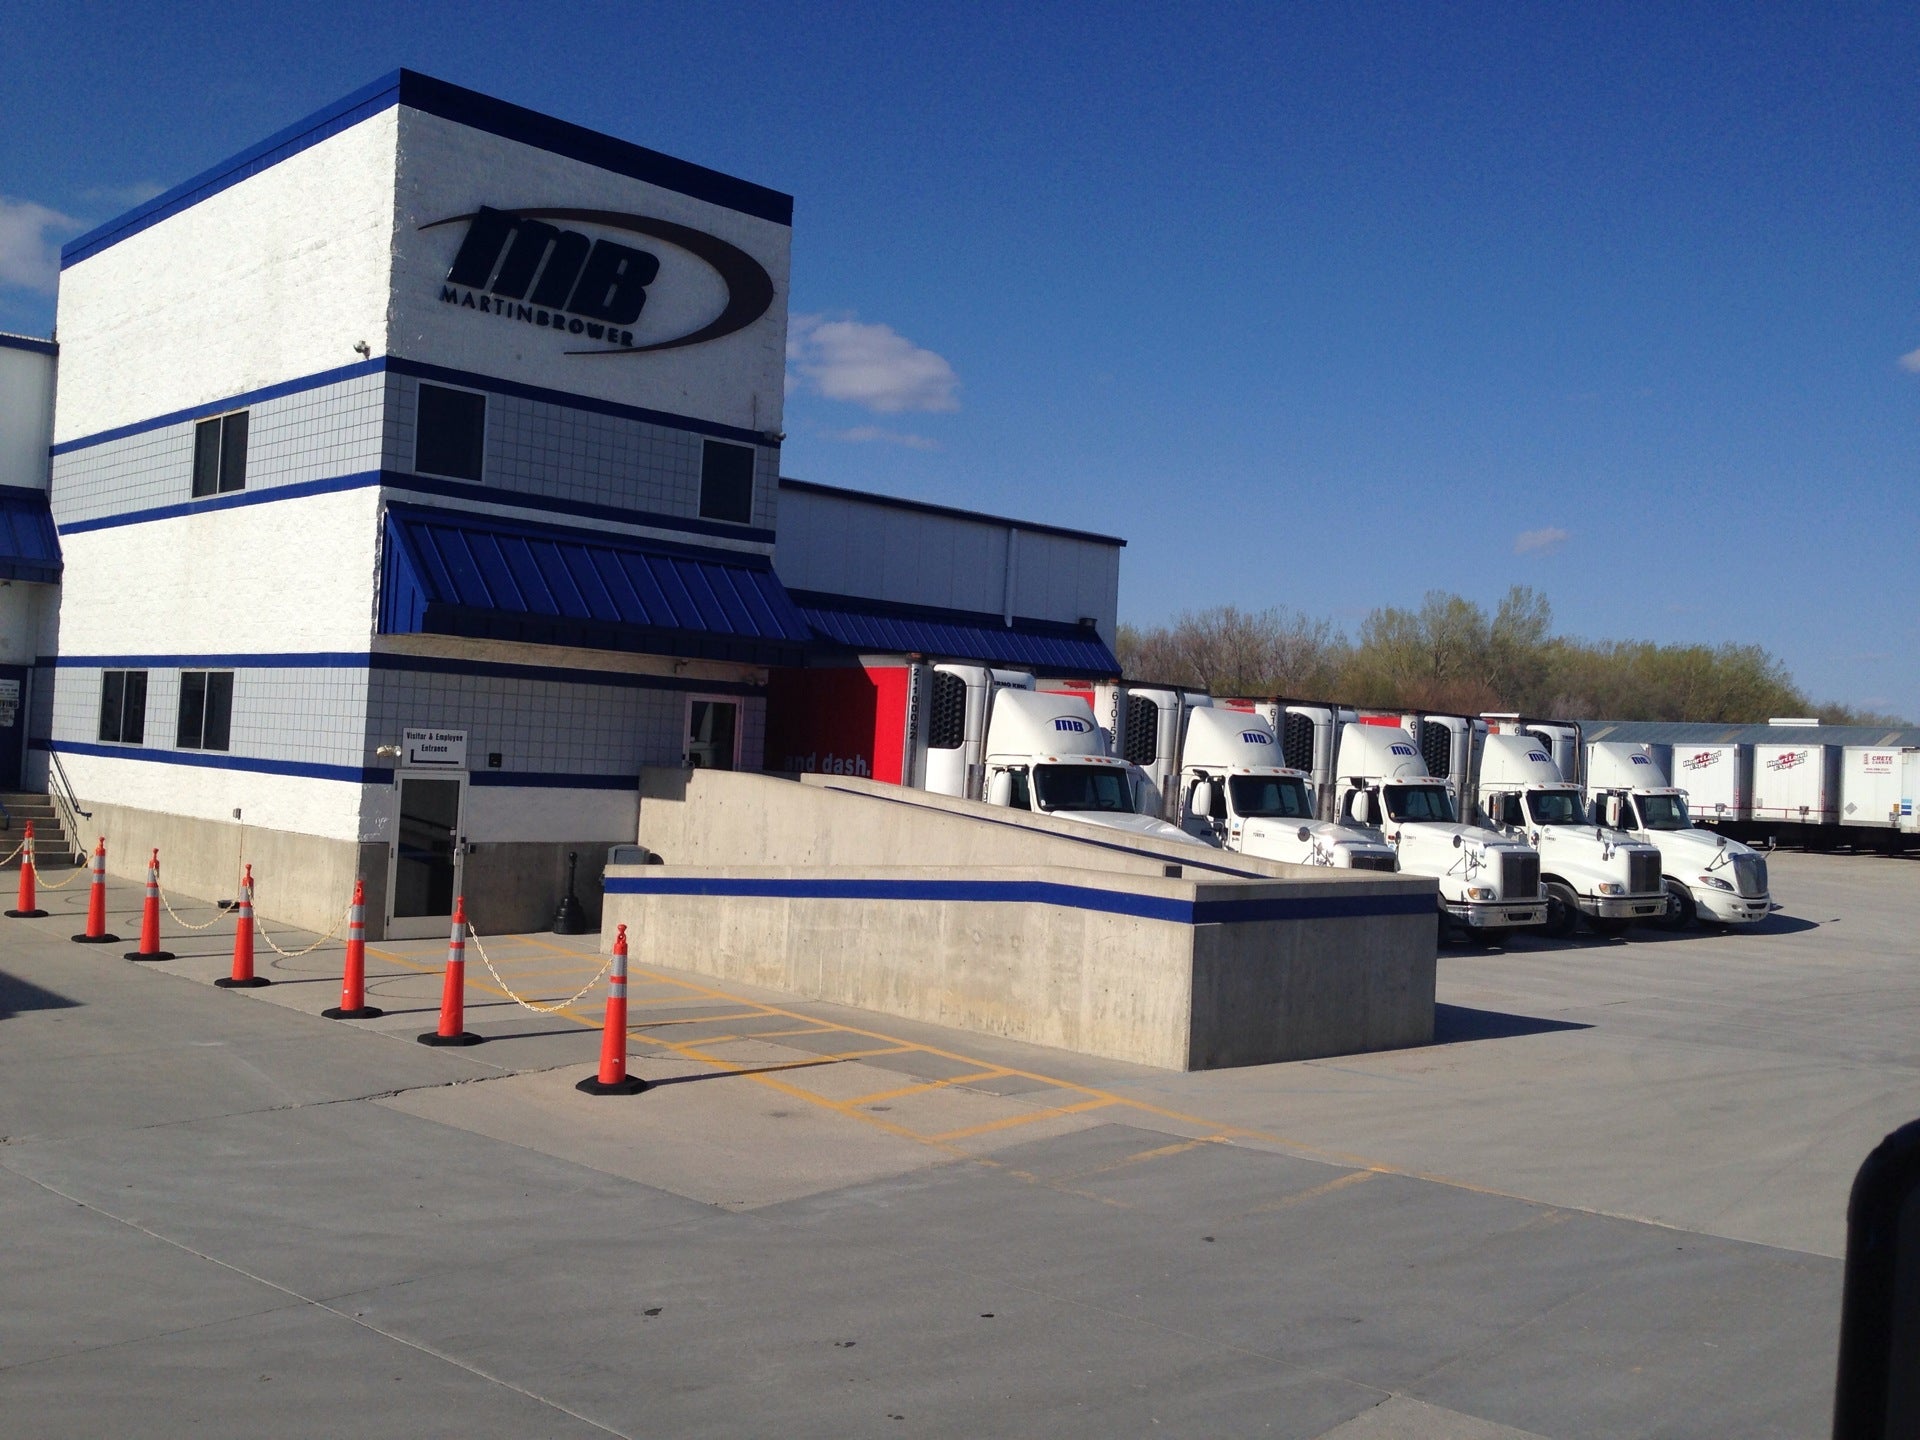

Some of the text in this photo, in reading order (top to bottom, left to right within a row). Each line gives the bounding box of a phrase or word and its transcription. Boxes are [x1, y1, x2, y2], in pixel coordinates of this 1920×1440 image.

[439, 285, 634, 347] MARTINBROWER
[1110, 691, 1119, 745] 610152
[406, 732, 427, 740] Visitor
[435, 733, 463, 742] Employee
[421, 744, 448, 752] Entrance
[784, 751, 871, 777] and dash.
